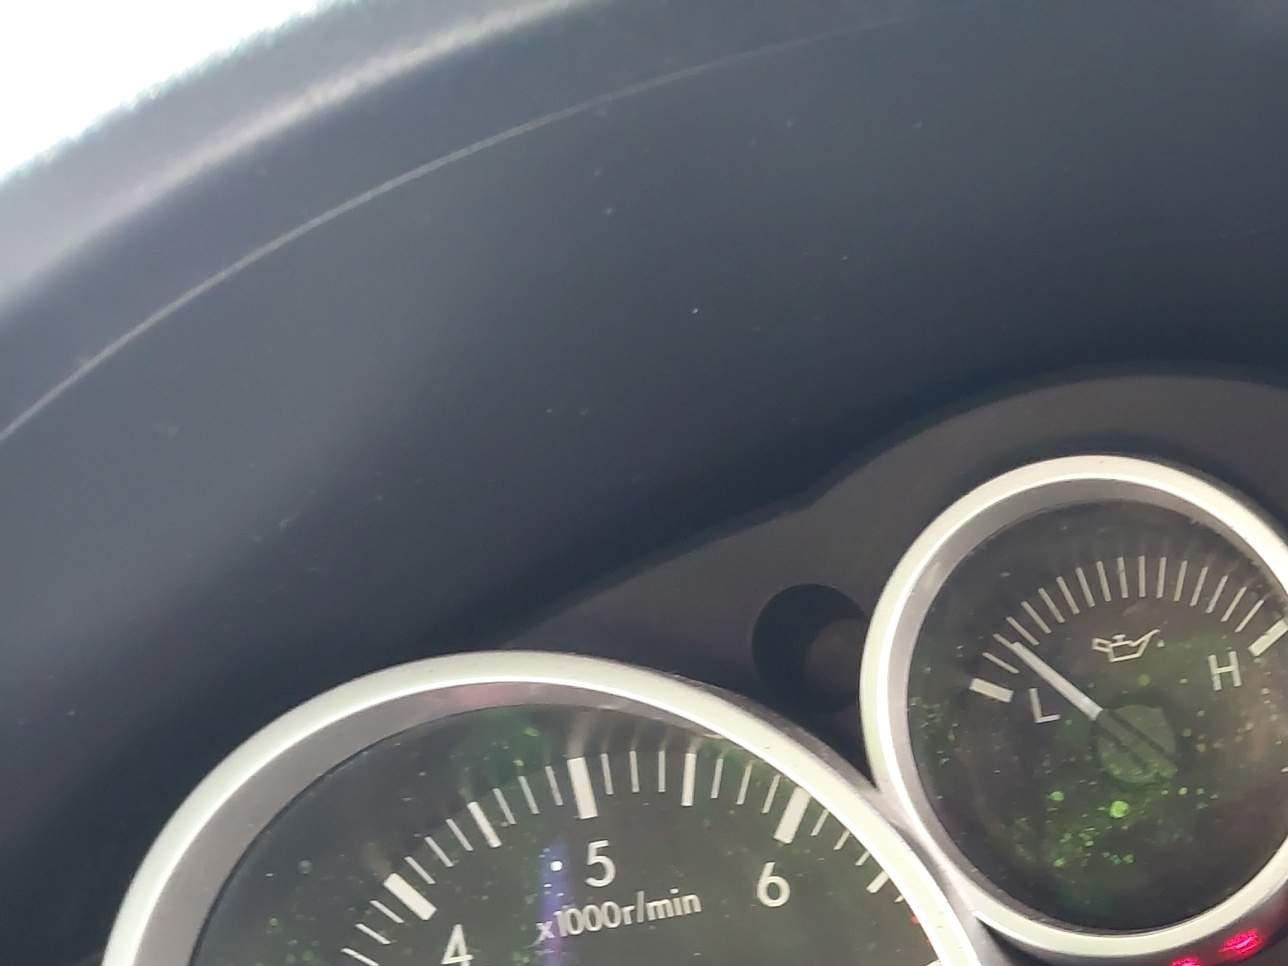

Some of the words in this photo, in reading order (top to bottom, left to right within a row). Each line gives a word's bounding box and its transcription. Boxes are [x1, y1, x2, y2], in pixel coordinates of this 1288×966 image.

[1208, 651, 1242, 690] H
[1028, 688, 1060, 723] L
[585, 839, 616, 888] 5
[757, 861, 791, 908] 6
